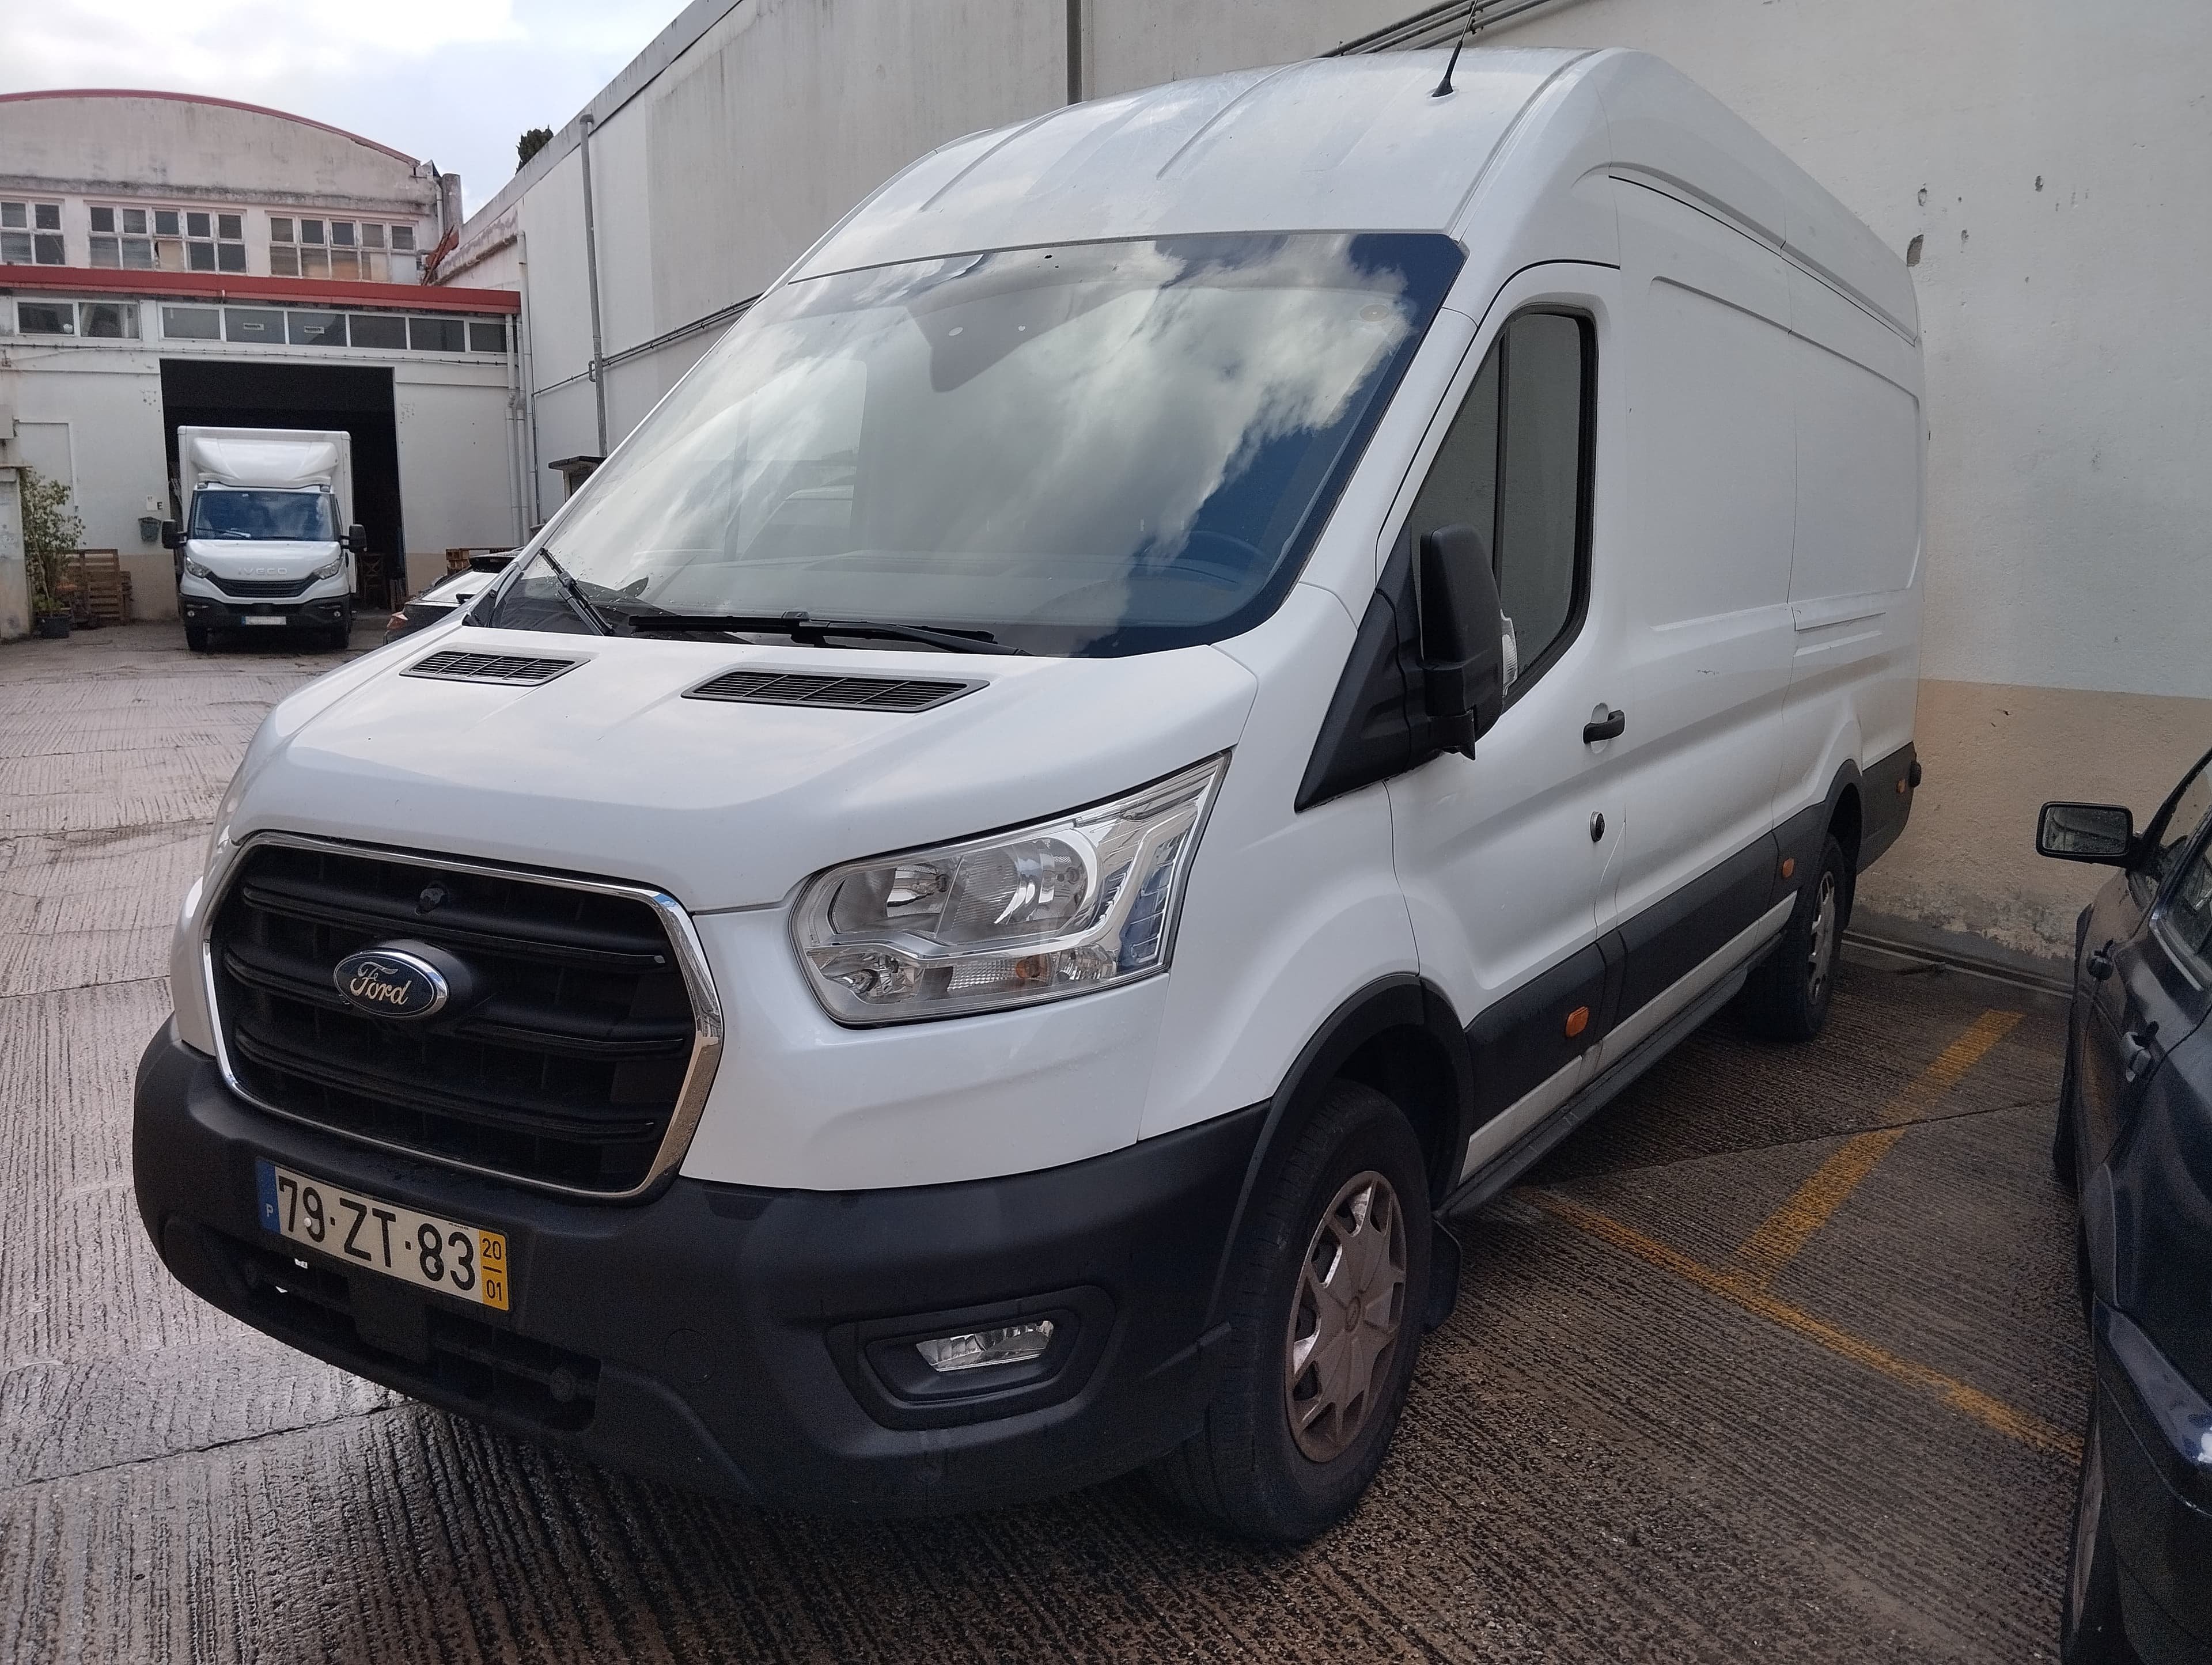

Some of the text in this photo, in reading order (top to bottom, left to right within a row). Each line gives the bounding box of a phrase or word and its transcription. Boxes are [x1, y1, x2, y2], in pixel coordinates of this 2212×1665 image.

[157, 502, 163, 510] E
[238, 567, 287, 575] IVECO
[350, 961, 412, 1005] Ford
[266, 1203, 274, 1218] P
[482, 1237, 502, 1261] 20
[486, 1279, 502, 1302] 01
